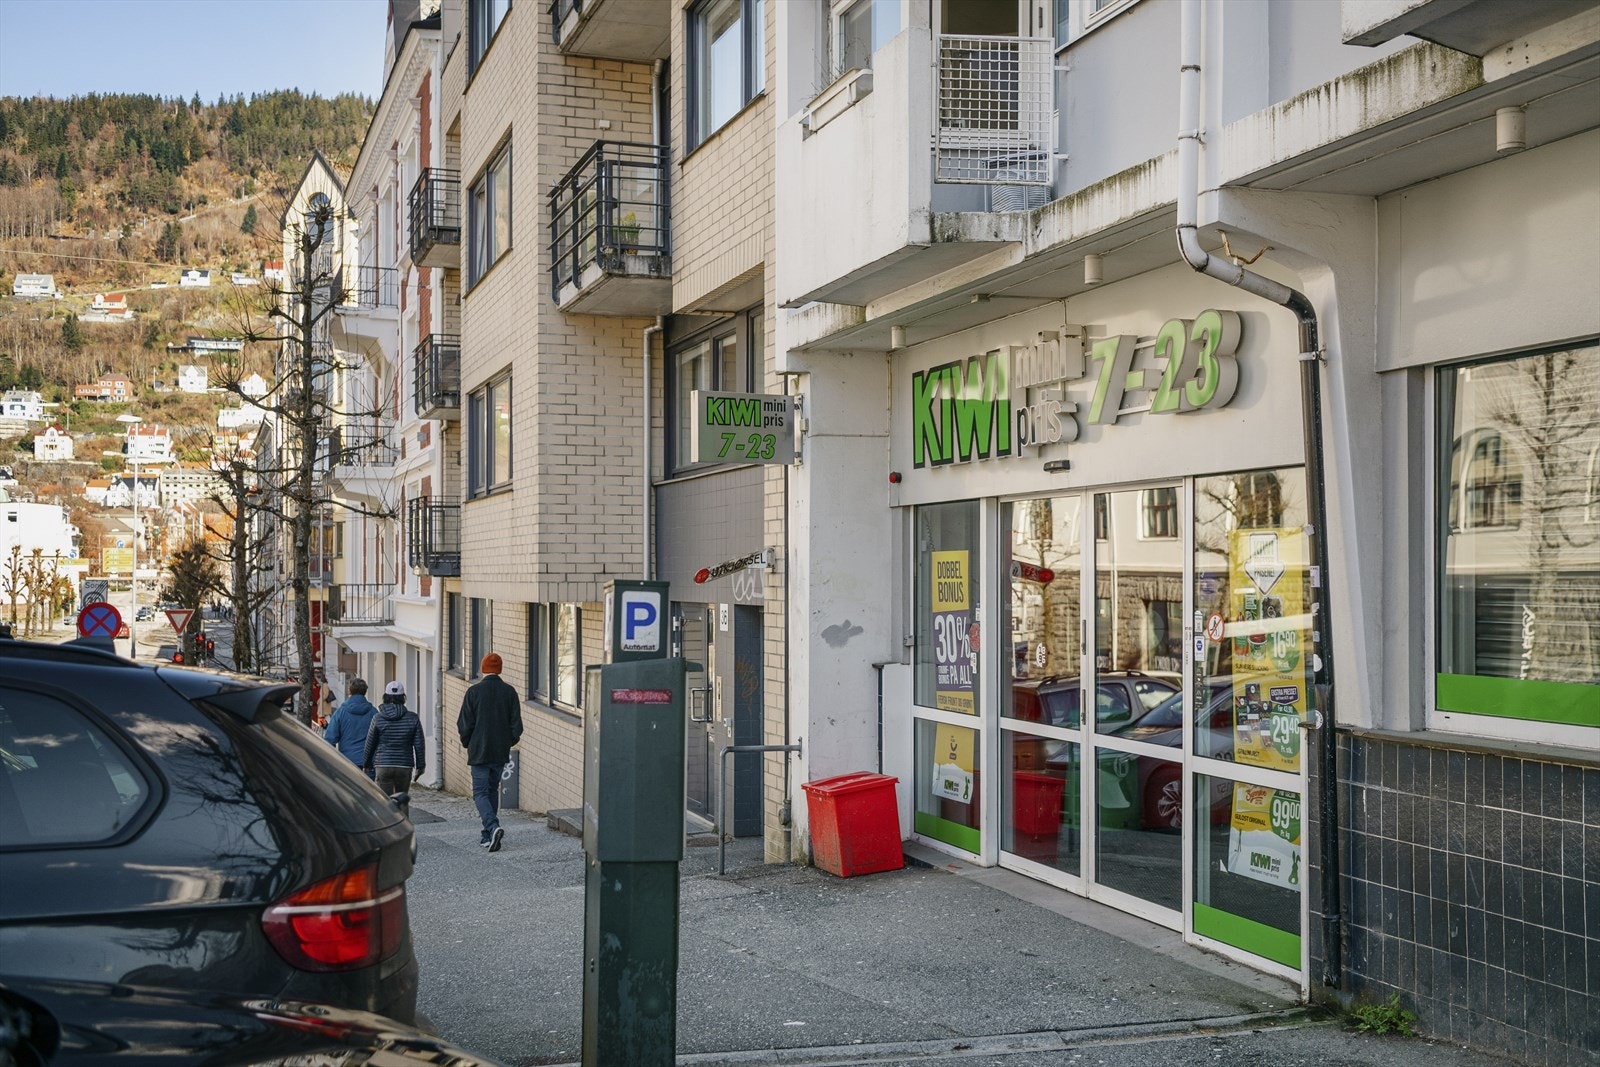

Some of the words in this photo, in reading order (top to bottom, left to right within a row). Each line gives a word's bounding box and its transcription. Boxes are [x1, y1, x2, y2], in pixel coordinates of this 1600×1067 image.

[1015, 332, 1068, 389] mini
[1087, 309, 1232, 425] 7-23
[706, 396, 762, 427] KIWI
[763, 399, 786, 412] mini
[912, 348, 1012, 470] KIWI
[763, 413, 784, 428] pris
[1016, 389, 1063, 459] pris
[718, 432, 777, 459] 7-23
[937, 560, 963, 579] DOBBEL
[938, 581, 964, 603] BONUS
[626, 602, 657, 640] P
[934, 614, 971, 663] 30%
[960, 665, 972, 685] ALL
[1250, 851, 1271, 870] KIWI
